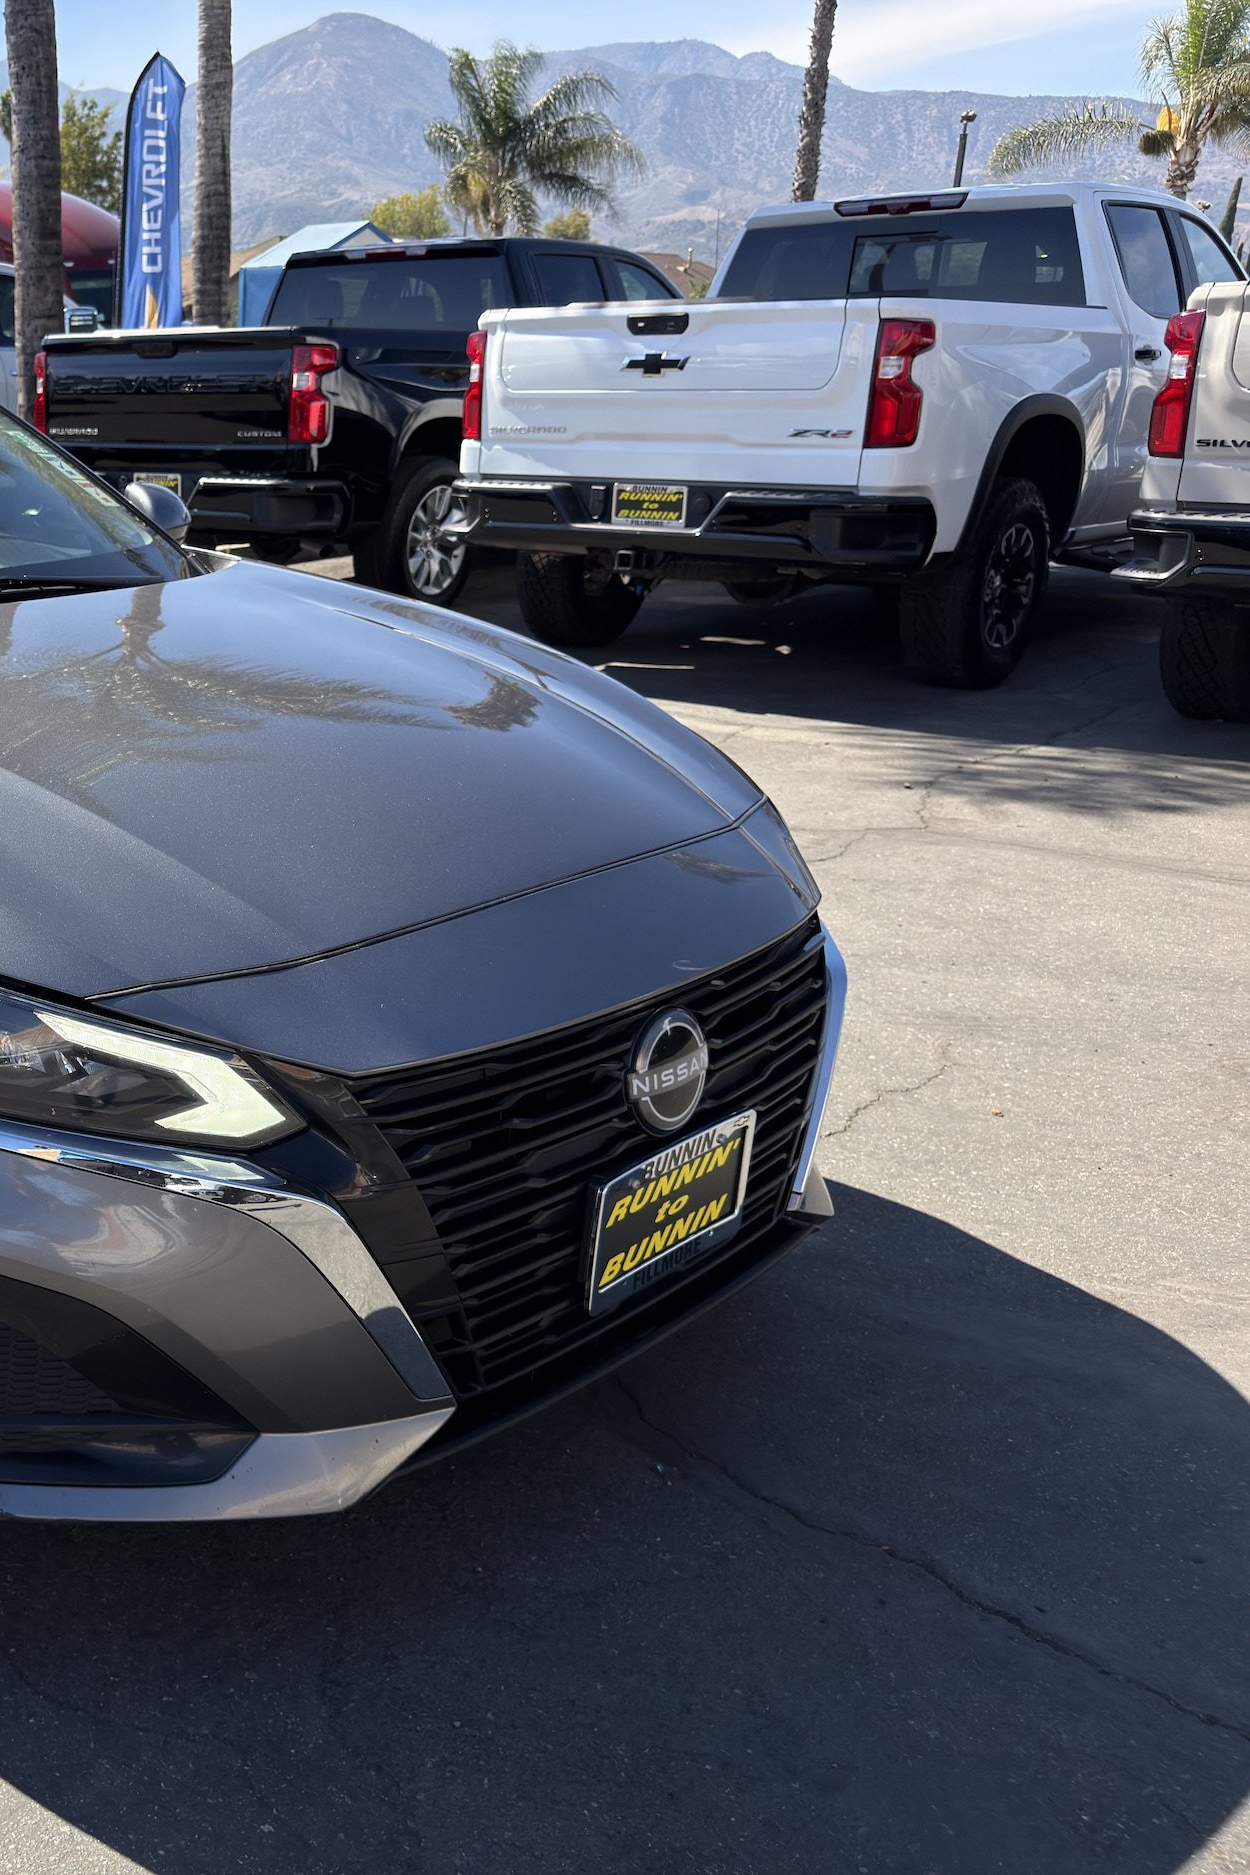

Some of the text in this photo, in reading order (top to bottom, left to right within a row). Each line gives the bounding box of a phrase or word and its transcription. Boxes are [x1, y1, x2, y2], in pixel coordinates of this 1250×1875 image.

[141, 79, 168, 273] CHEVROLET
[237, 430, 282, 438] CUSTOM
[617, 509, 679, 520] BUNNIN
[642, 502, 659, 510] to
[632, 1052, 708, 1096] NISSAN
[606, 1137, 742, 1229] RUNNIN'
[654, 1194, 690, 1224] to
[598, 1192, 728, 1287] BUNNIN
